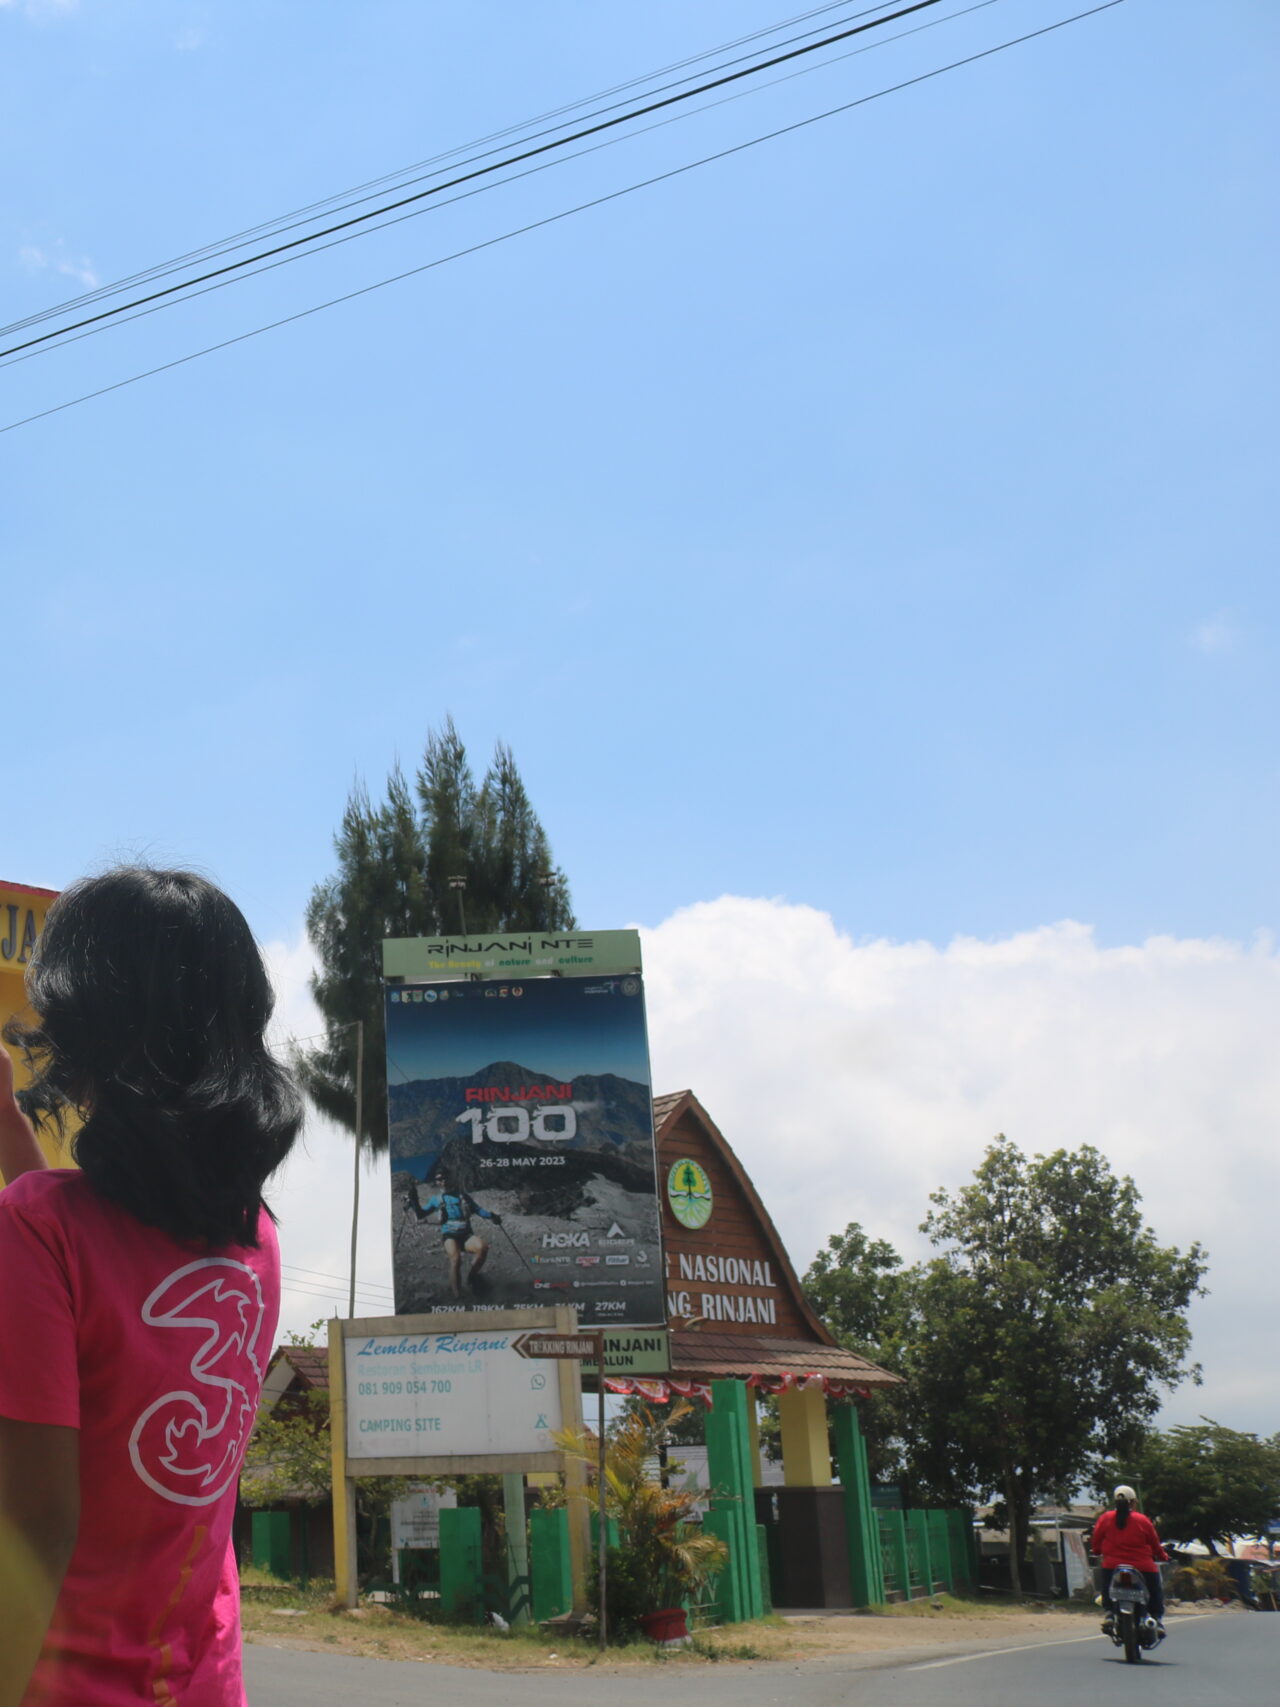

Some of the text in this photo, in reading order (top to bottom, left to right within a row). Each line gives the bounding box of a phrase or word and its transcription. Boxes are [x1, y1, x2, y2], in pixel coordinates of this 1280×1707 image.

[465, 1084, 573, 1103] RINJANI
[455, 1104, 577, 1145] 100
[480, 1156, 566, 1168] 26-28 MAY 2023
[542, 1233, 590, 1248] HOKA
[680, 1253, 777, 1288] NASIONAL
[594, 1301, 627, 1311] 27KM
[666, 1291, 777, 1325] NG RINJANI
[357, 1335, 510, 1357] Lembah Rinjani
[604, 1338, 661, 1353] INJANI
[358, 1379, 452, 1395] 081 909 054 700
[359, 1417, 441, 1433] CAMPING SITE
